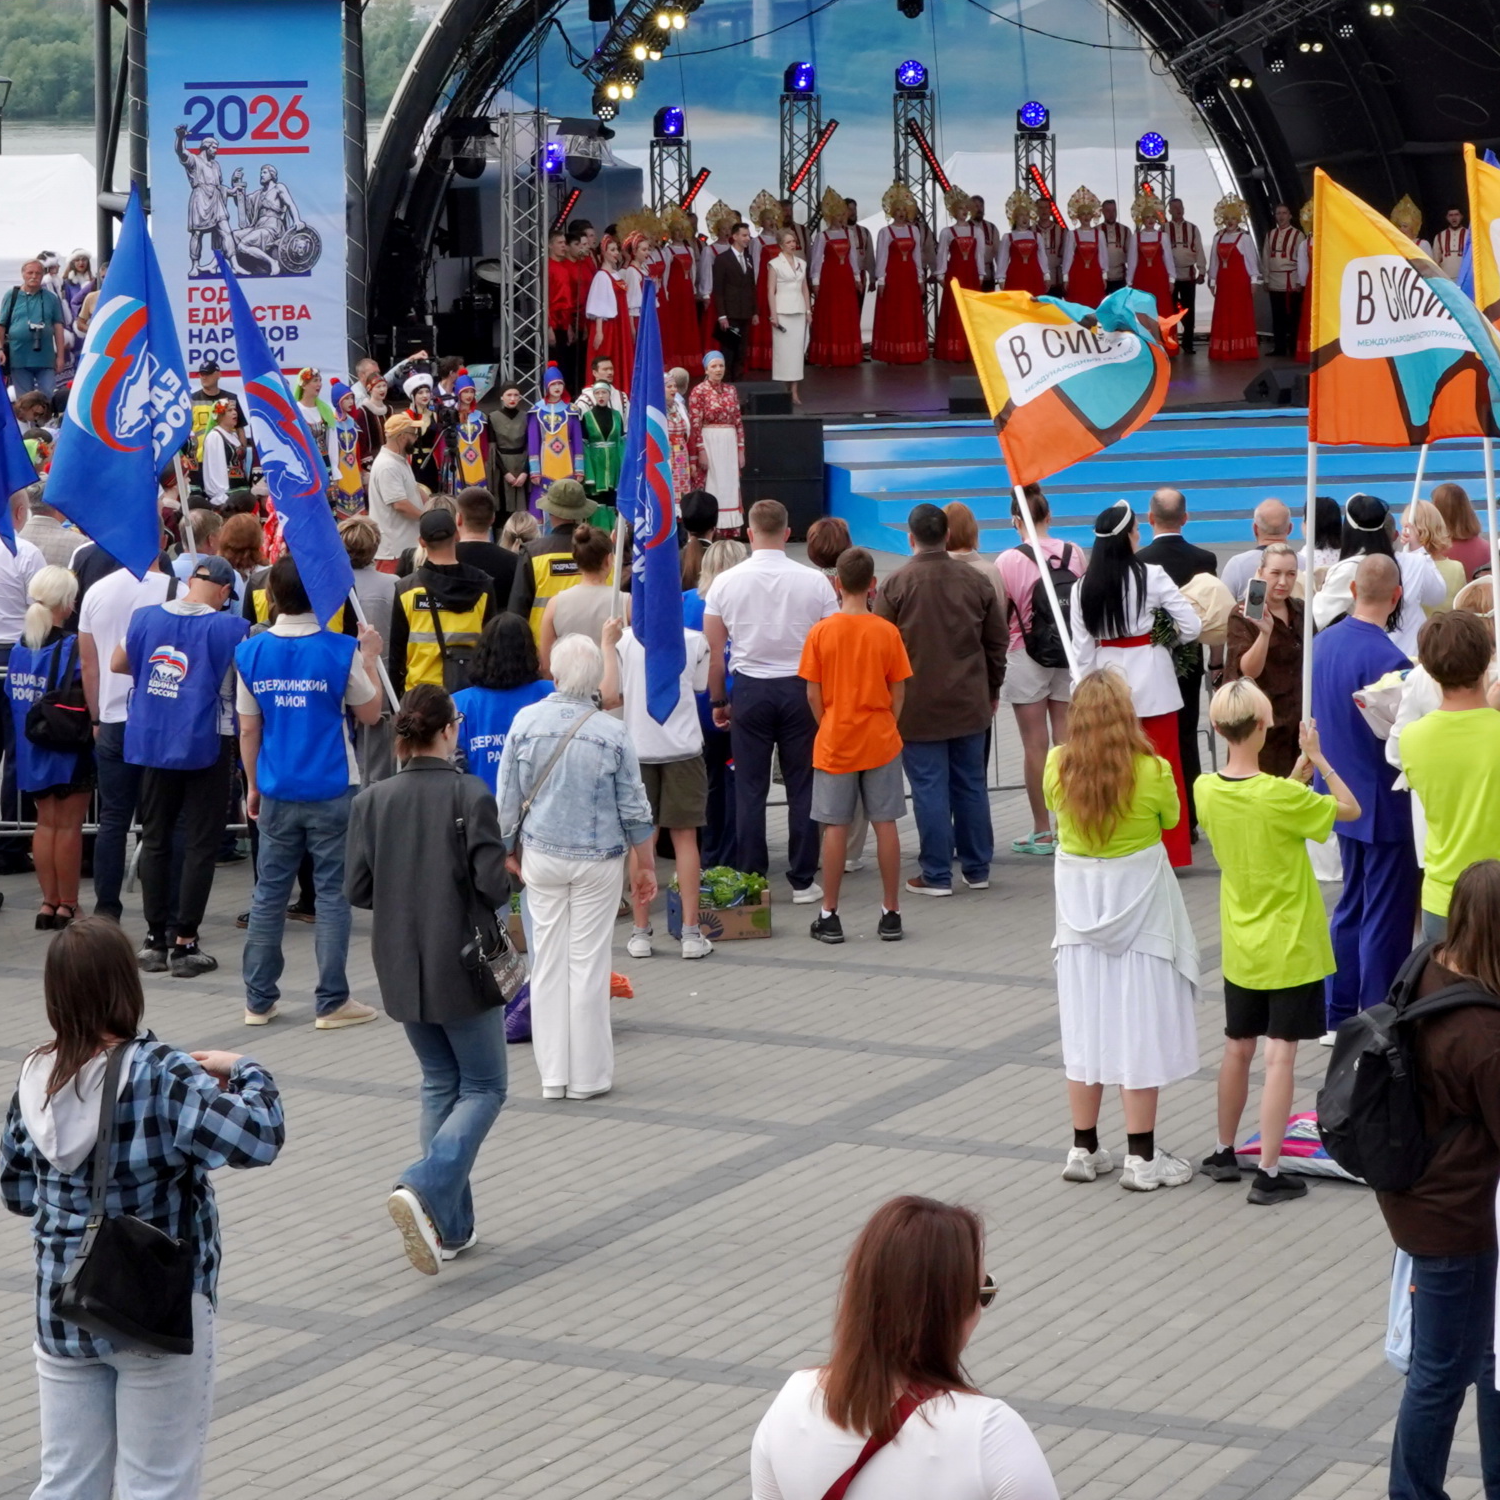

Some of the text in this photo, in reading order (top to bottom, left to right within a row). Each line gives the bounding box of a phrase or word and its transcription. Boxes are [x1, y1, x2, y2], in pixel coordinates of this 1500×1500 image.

[184, 94, 310, 142] 2026
[1356, 270, 1375, 325] В
[188, 304, 312, 326] ЕДИСТВА
[1009, 335, 1033, 379] В
[147, 687, 178, 699] РОССИЯ
[148, 679, 179, 691] ЕДИНАЯ
[252, 678, 328, 695] ДЗЕРЖИНСКИЙ
[275, 693, 306, 707] РАЙОН
